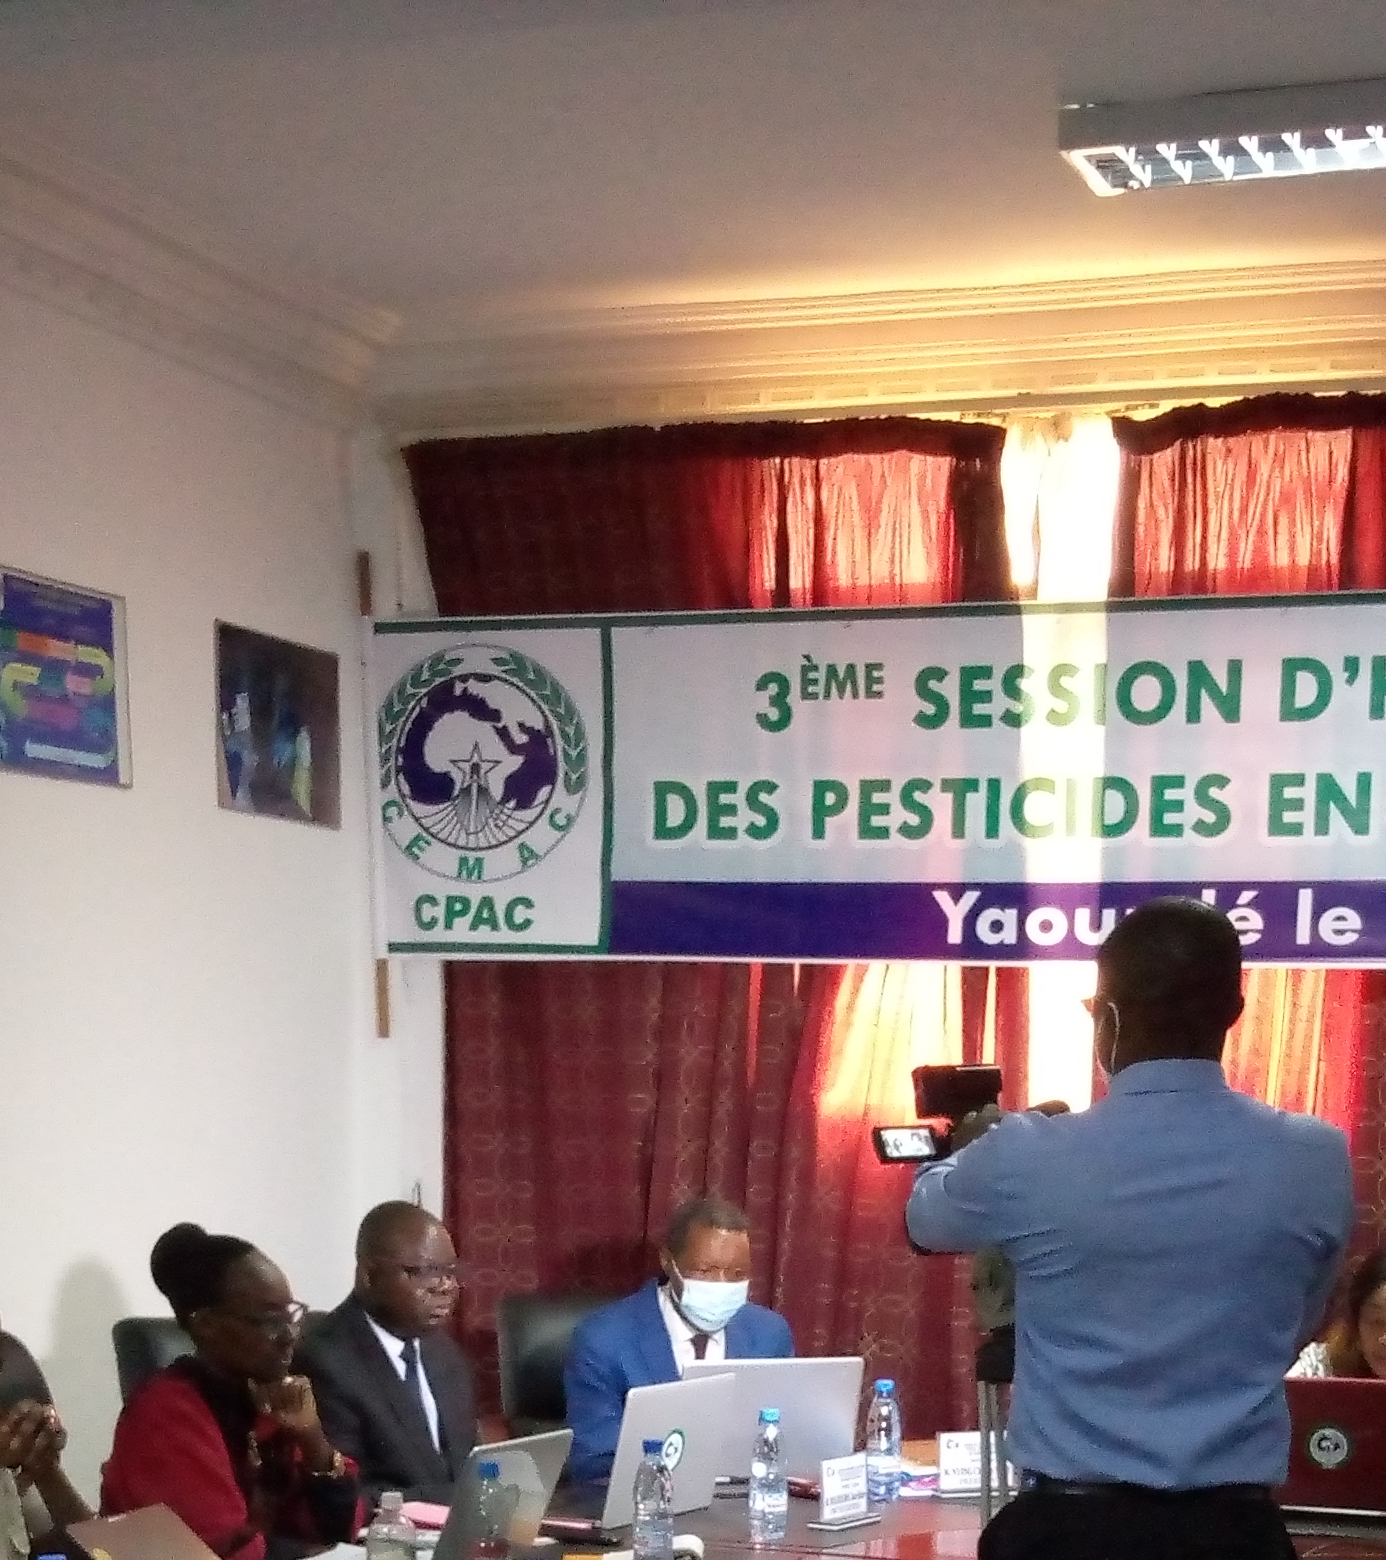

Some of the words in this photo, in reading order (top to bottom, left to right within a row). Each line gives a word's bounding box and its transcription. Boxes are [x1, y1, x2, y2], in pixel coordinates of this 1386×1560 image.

[912, 657, 1244, 731] SESSION
[380, 798, 575, 882] CEMAC
[652, 778, 781, 842] DES
[810, 772, 1233, 842] PESTICIDES
[1267, 770, 1373, 838] EN
[414, 893, 536, 933] CPAC
[931, 888, 1265, 947] Yaoué
[1294, 888, 1363, 947] le
